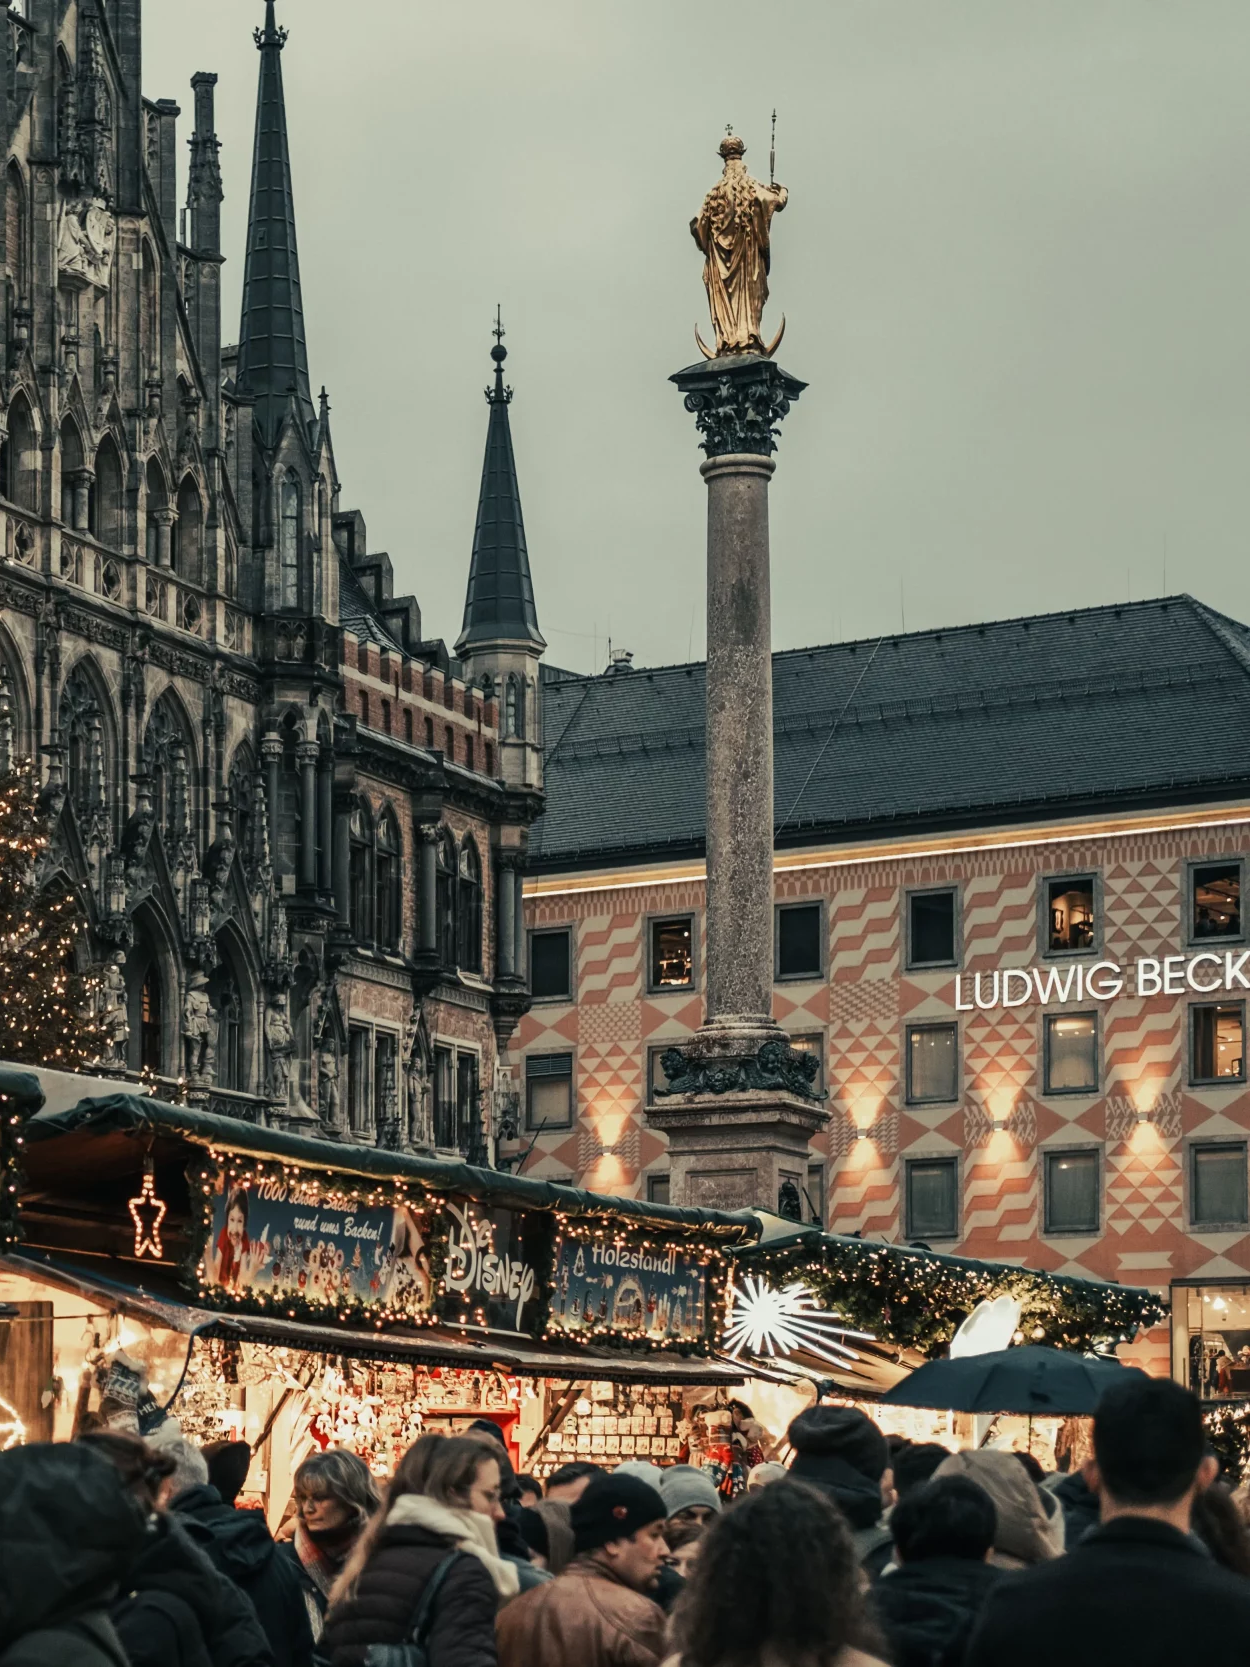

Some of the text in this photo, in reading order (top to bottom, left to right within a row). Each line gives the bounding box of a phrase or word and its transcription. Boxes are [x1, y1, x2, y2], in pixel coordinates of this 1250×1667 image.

[955, 950, 1250, 1012] LUDWIG BECK
[257, 1182, 288, 1203] 1000
[293, 1213, 384, 1241] rund ums Backen!
